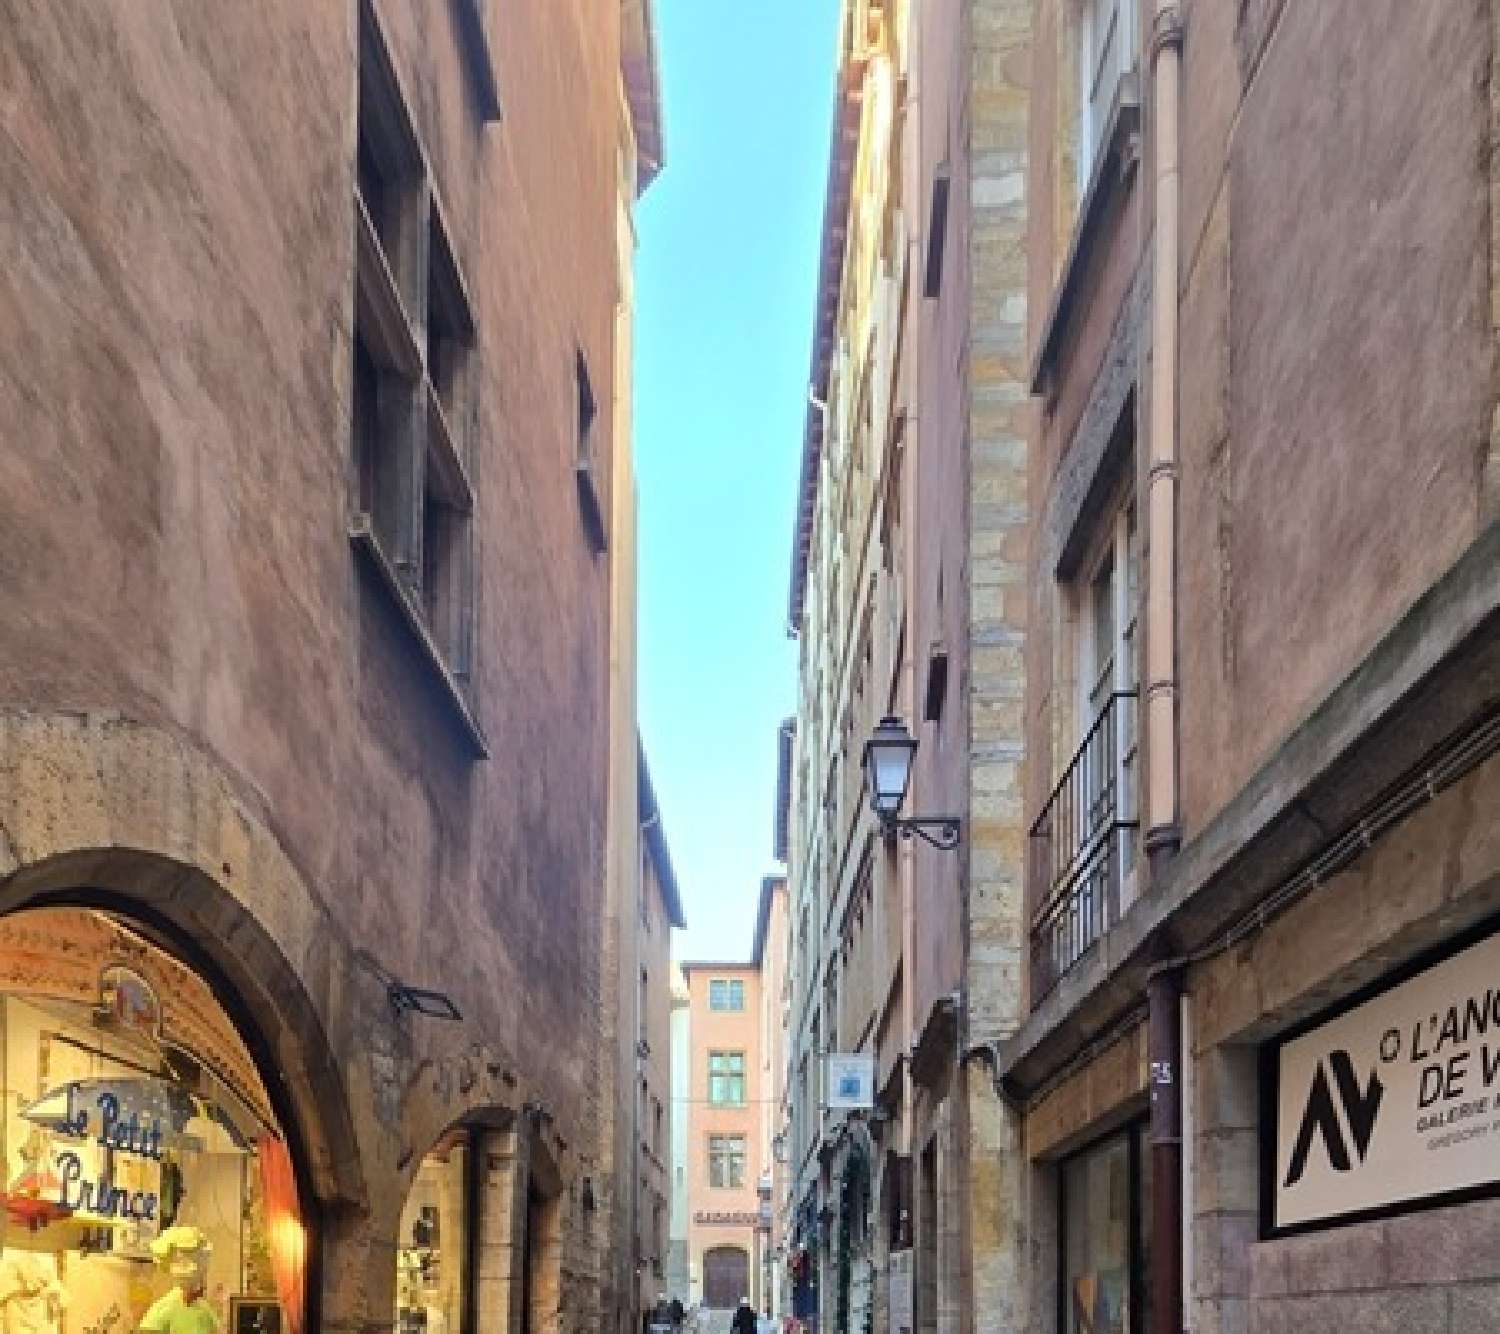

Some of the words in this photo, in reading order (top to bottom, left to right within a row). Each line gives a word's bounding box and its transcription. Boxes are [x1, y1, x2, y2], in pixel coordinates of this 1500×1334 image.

[1418, 1050, 1470, 1110] DE
[97, 1092, 163, 1160] Petit
[55, 1153, 158, 1220] Prince
